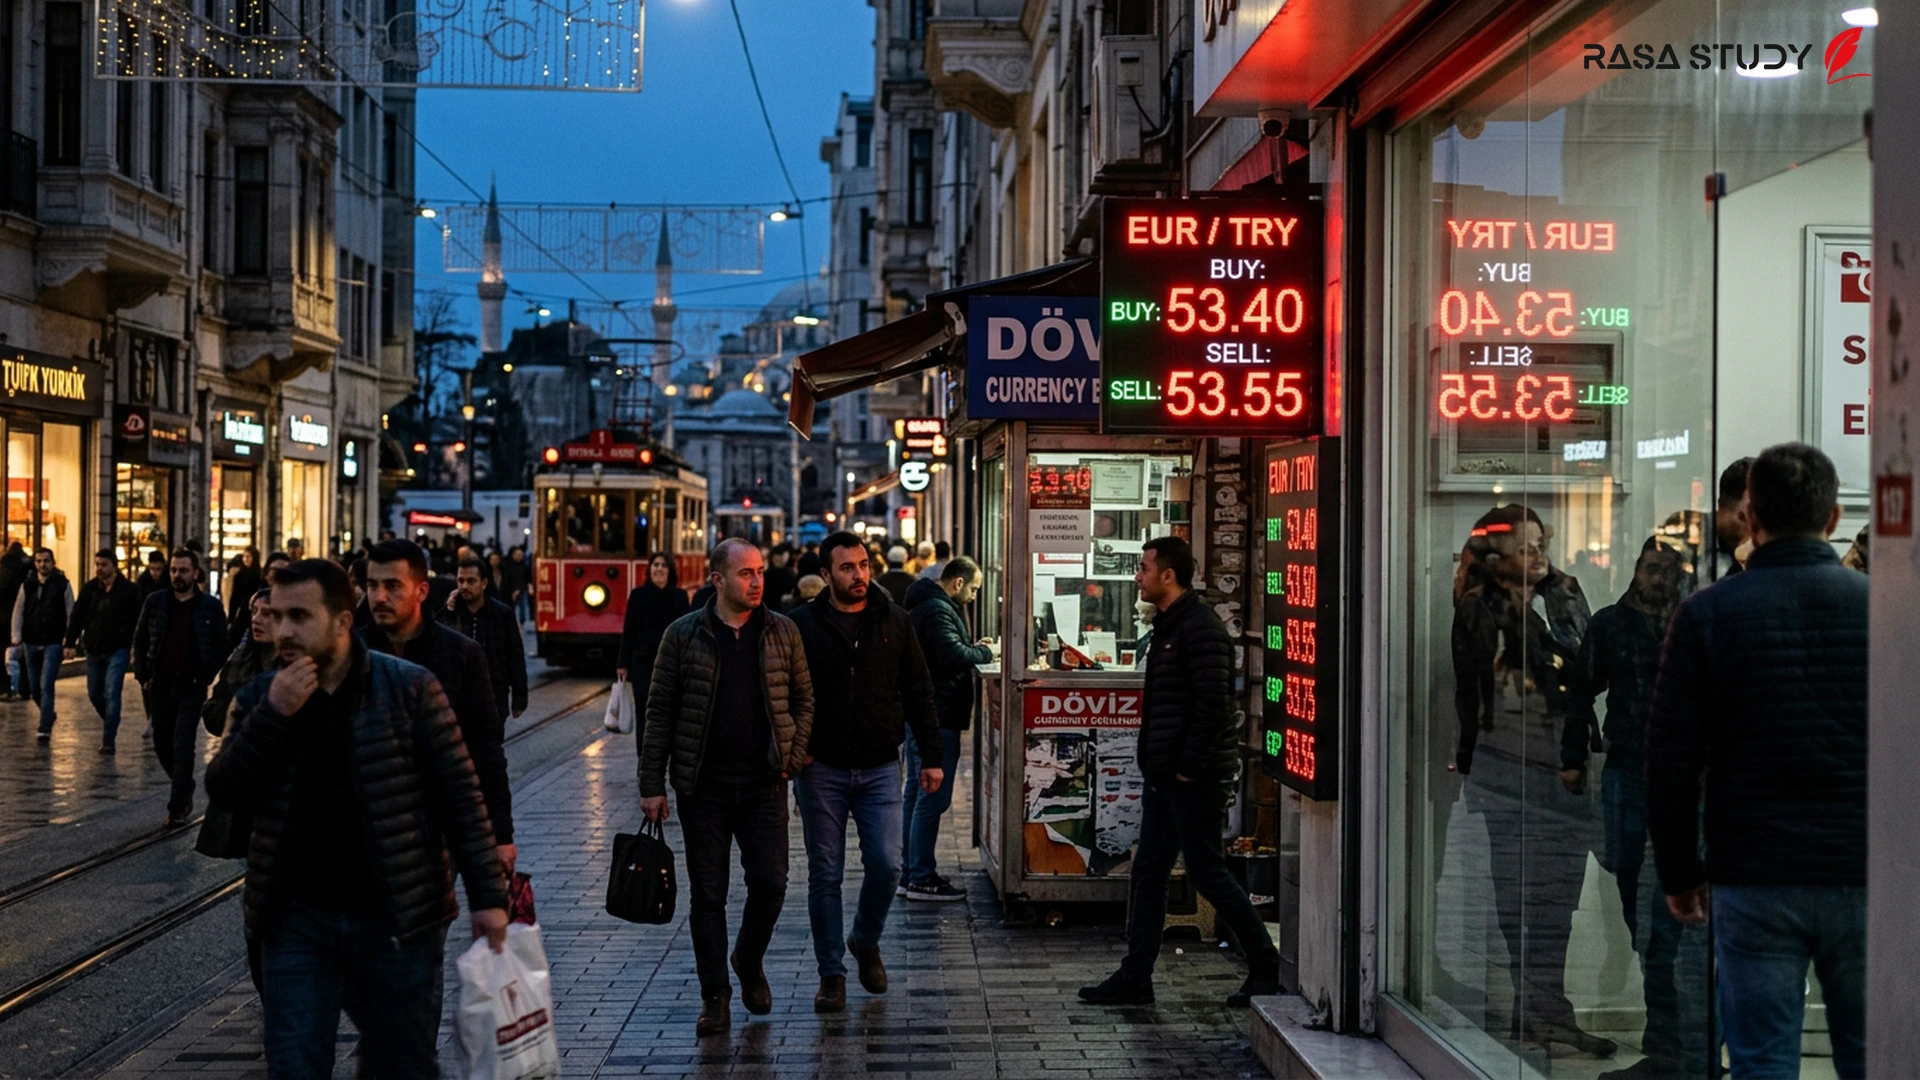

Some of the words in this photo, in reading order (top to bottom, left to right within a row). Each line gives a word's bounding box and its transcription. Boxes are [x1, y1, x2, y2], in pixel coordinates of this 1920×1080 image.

[1128, 216, 1199, 245] EUR
[1207, 217, 1220, 245] /
[1228, 217, 1298, 246] TRY
[1210, 259, 1266, 279] BUY:
[1110, 302, 1161, 322] BUY:
[1167, 288, 1303, 333] 53.40
[1205, 343, 1271, 364] SELL:
[986, 377, 1087, 403] CURRENCY
[1110, 381, 1162, 401] SELL:
[1167, 372, 1303, 417] 53.55
[1041, 691, 1139, 714] DÖVİZ
